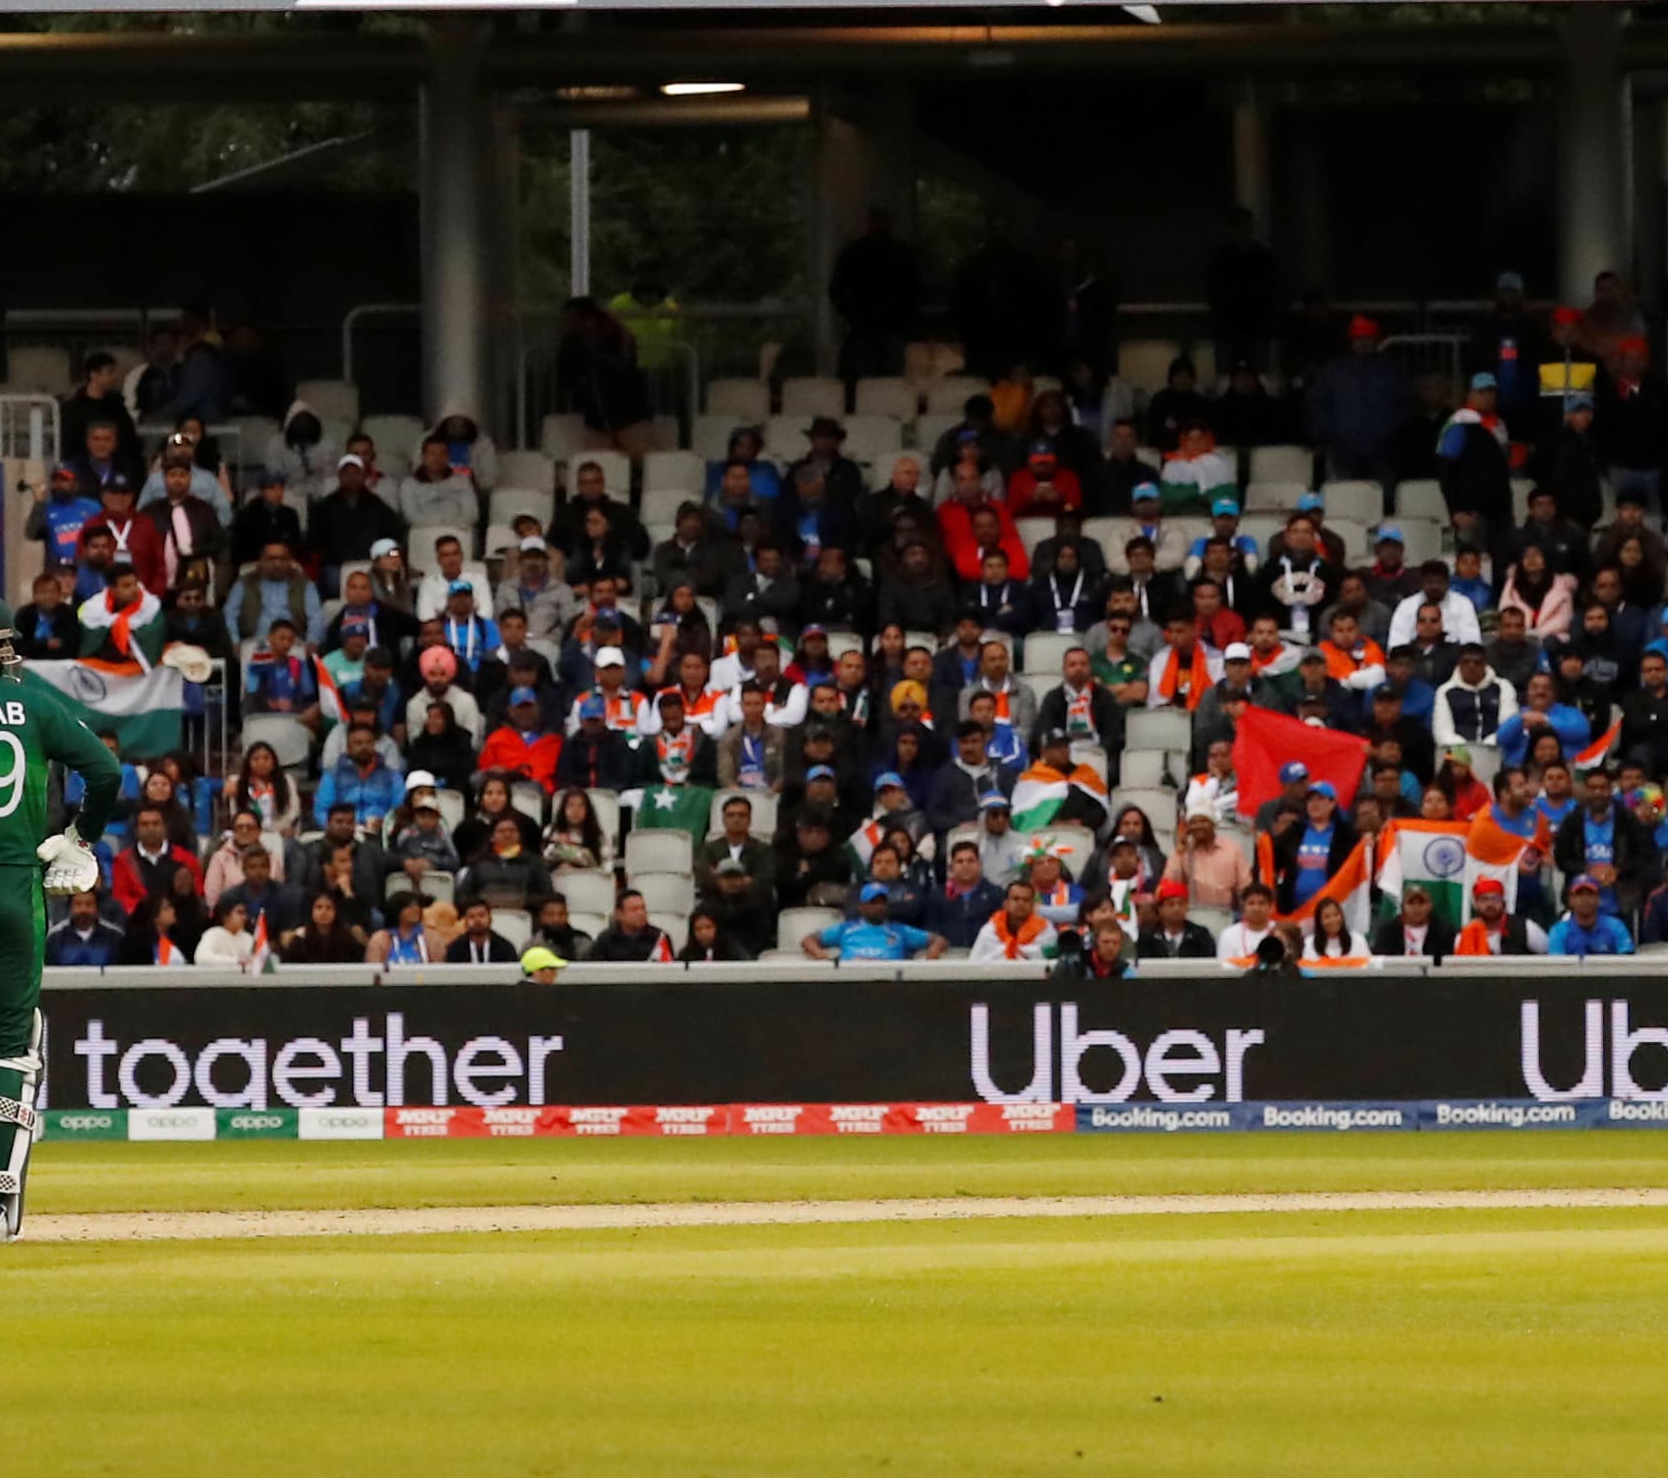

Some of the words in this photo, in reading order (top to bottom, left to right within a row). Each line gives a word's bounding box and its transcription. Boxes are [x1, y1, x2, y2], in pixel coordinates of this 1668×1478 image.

[73, 1011, 564, 1110] together
[969, 1001, 1266, 1104] Uber
[395, 1109, 457, 1124] MRF
[482, 1109, 543, 1124] MRF
[568, 1108, 630, 1123] MRF
[655, 1108, 716, 1123] MRF
[743, 1107, 804, 1122] MRF
[830, 1106, 890, 1121] MRF
[915, 1106, 976, 1121] MRF
[1001, 1104, 1062, 1119] MRF
[1092, 1107, 1230, 1131] Booking.com
[1264, 1106, 1403, 1129] Booking.com
[1436, 1104, 1576, 1127] Booking.com
[59, 1114, 112, 1131] oppo
[147, 1114, 198, 1130] oppo
[230, 1113, 284, 1130] oppo
[318, 1114, 370, 1130] oppo
